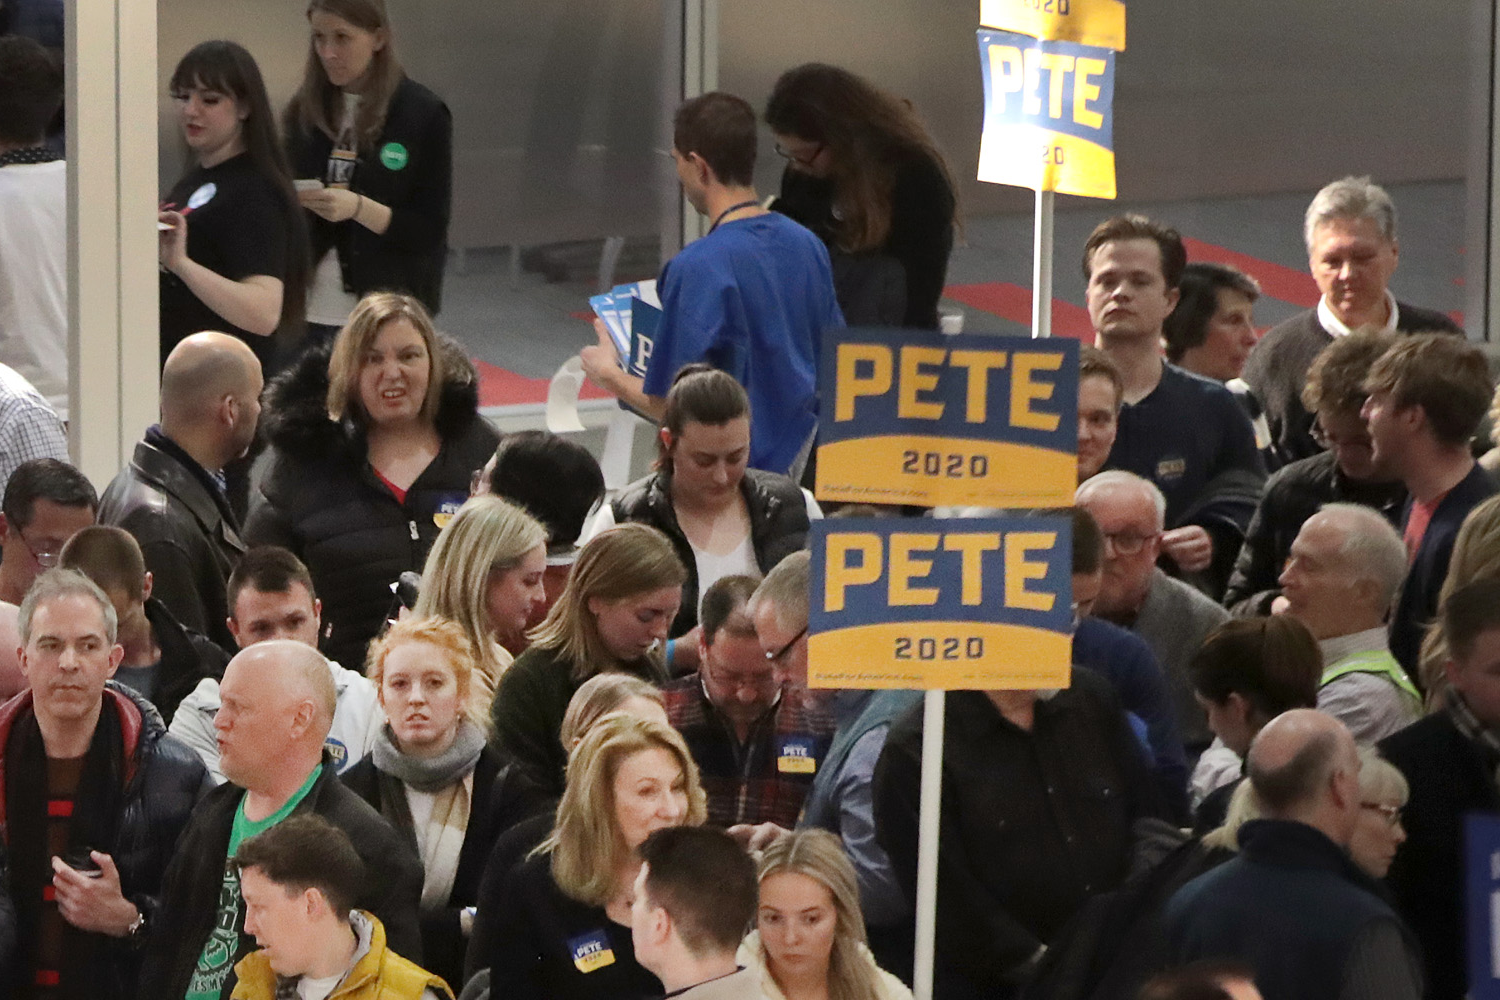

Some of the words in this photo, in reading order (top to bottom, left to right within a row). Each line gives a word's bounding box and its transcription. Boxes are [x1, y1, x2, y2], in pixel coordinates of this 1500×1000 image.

[987, 44, 1107, 130] PETE
[834, 343, 1065, 432] PETE
[902, 450, 988, 478] 2020
[824, 532, 1057, 617] PETE
[895, 637, 983, 660] 2020
[576, 942, 603, 958] PETE
